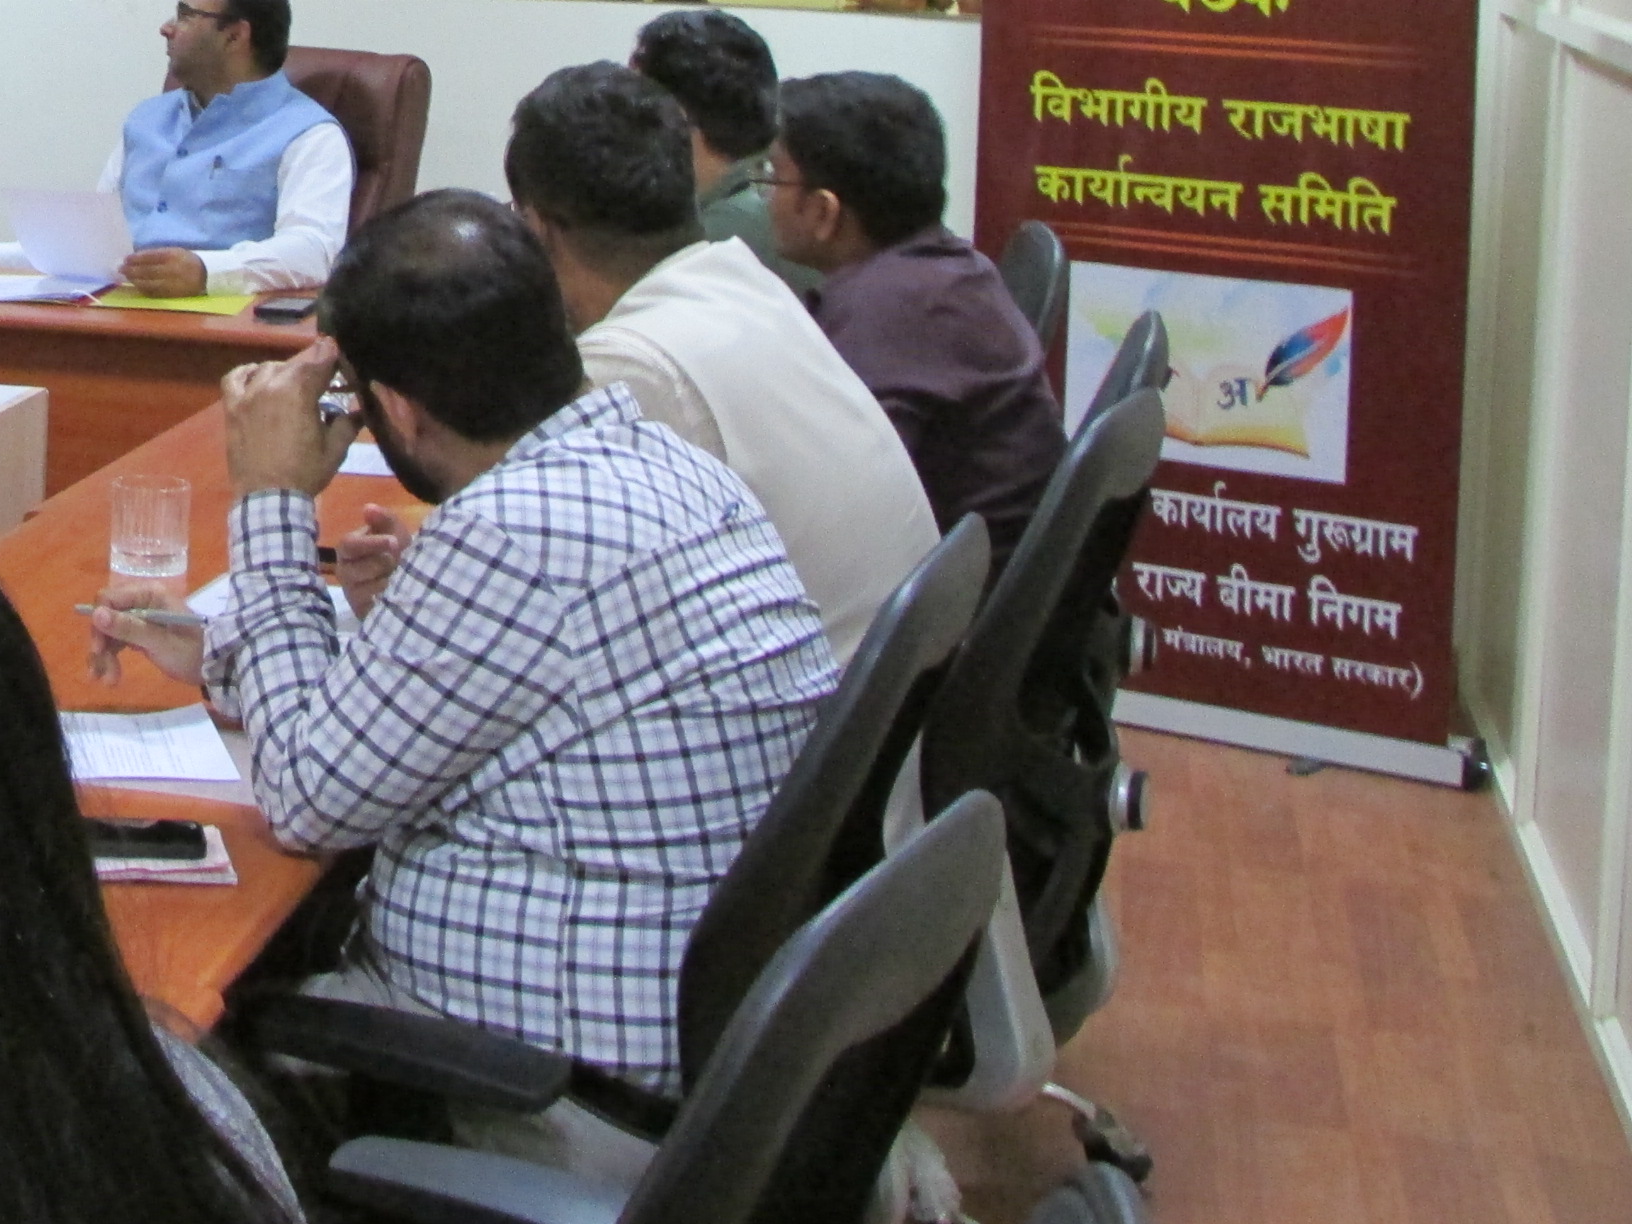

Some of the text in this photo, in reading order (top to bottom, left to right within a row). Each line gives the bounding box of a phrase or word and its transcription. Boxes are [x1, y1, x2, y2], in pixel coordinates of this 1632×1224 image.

[1029, 69, 1412, 152] विभागीय राजभाषा
[1033, 153, 1398, 237] कार्यान्वयन समिति
[1149, 480, 1419, 564] कार्यालय गुरूग्राम
[1131, 561, 1403, 641] राज्य बीमा निगम
[1161, 625, 1252, 670] मंत्रालय,
[1261, 644, 1325, 676] भारत
[1330, 656, 1425, 701] सरकार)
